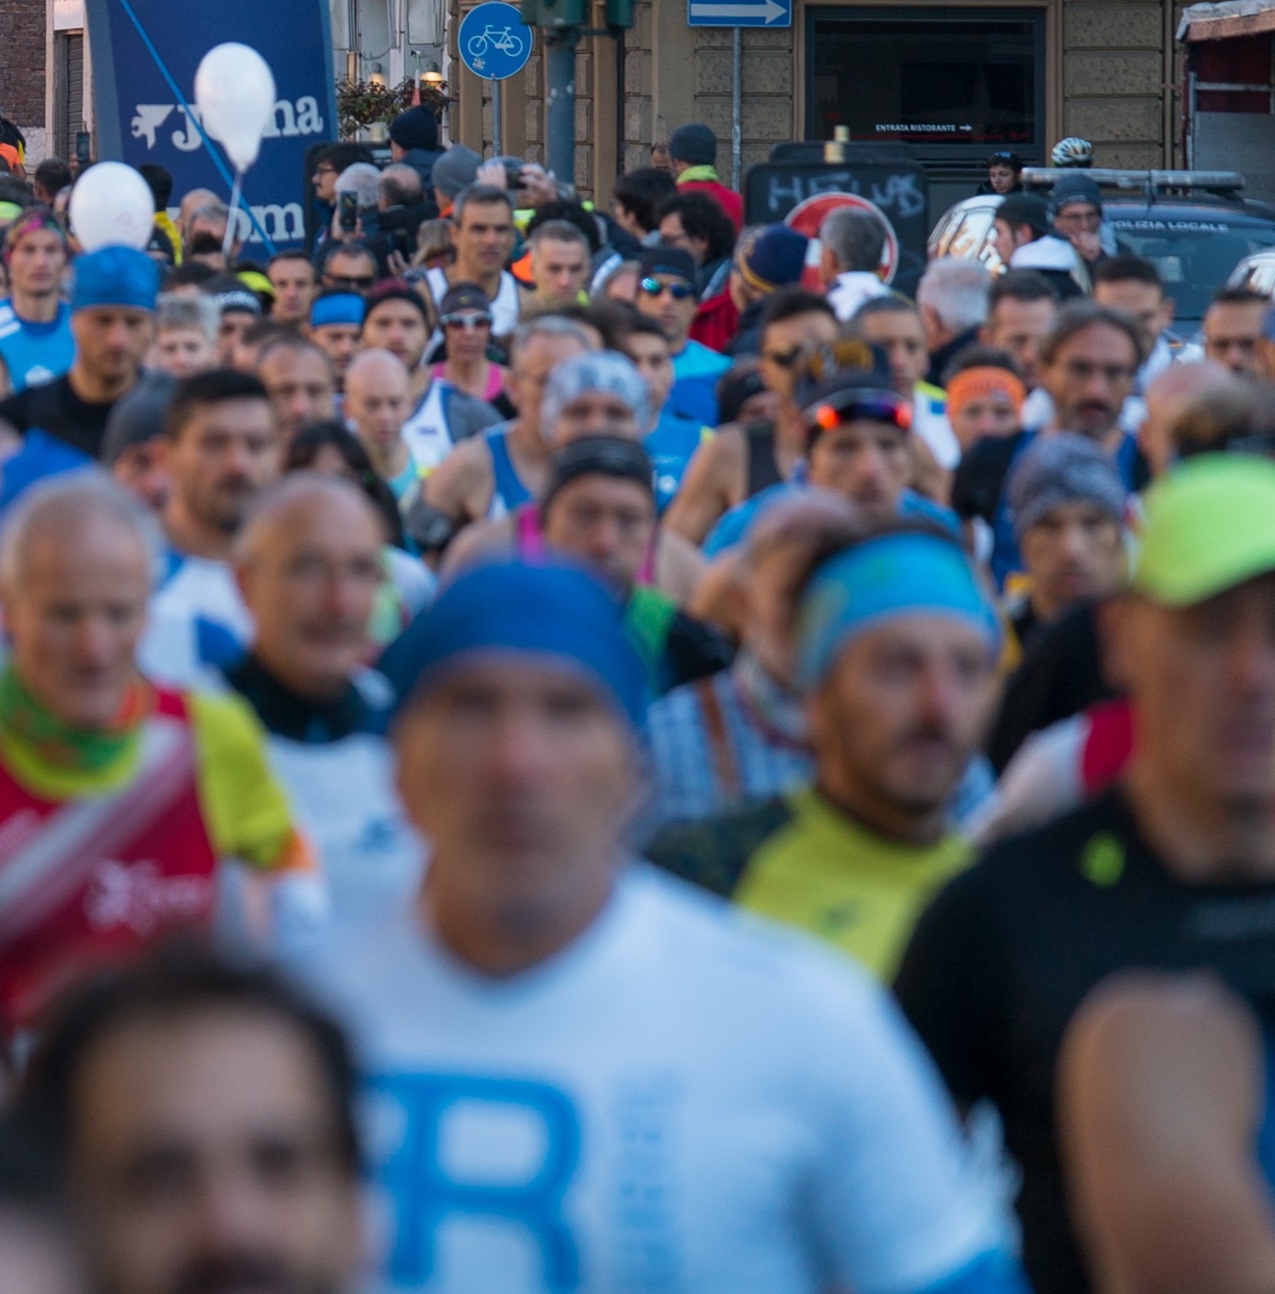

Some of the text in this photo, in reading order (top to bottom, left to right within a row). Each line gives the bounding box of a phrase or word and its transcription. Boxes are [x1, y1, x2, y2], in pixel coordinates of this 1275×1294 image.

[875, 124, 956, 132] ENTRATA RISTORANTE
[1167, 221, 1229, 232] LOCALE
